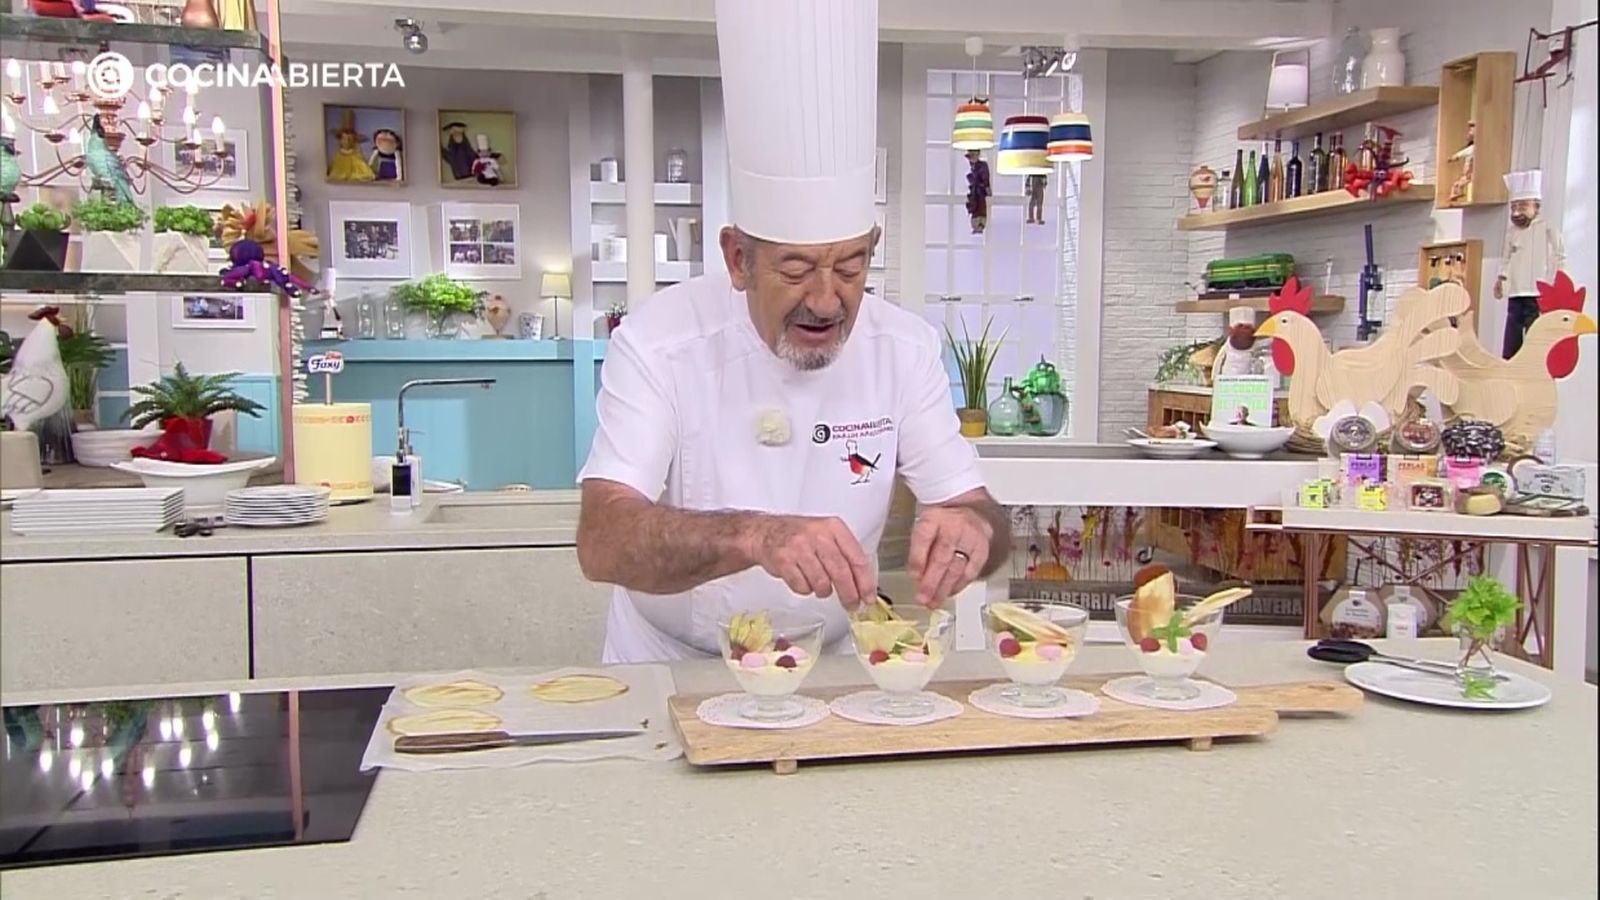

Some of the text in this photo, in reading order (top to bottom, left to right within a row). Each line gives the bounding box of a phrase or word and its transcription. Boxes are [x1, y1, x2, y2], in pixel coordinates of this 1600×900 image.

[311, 358, 341, 370] Foxy
[1351, 461, 1377, 470] PERLAS
[1398, 462, 1425, 471] PERLAS
